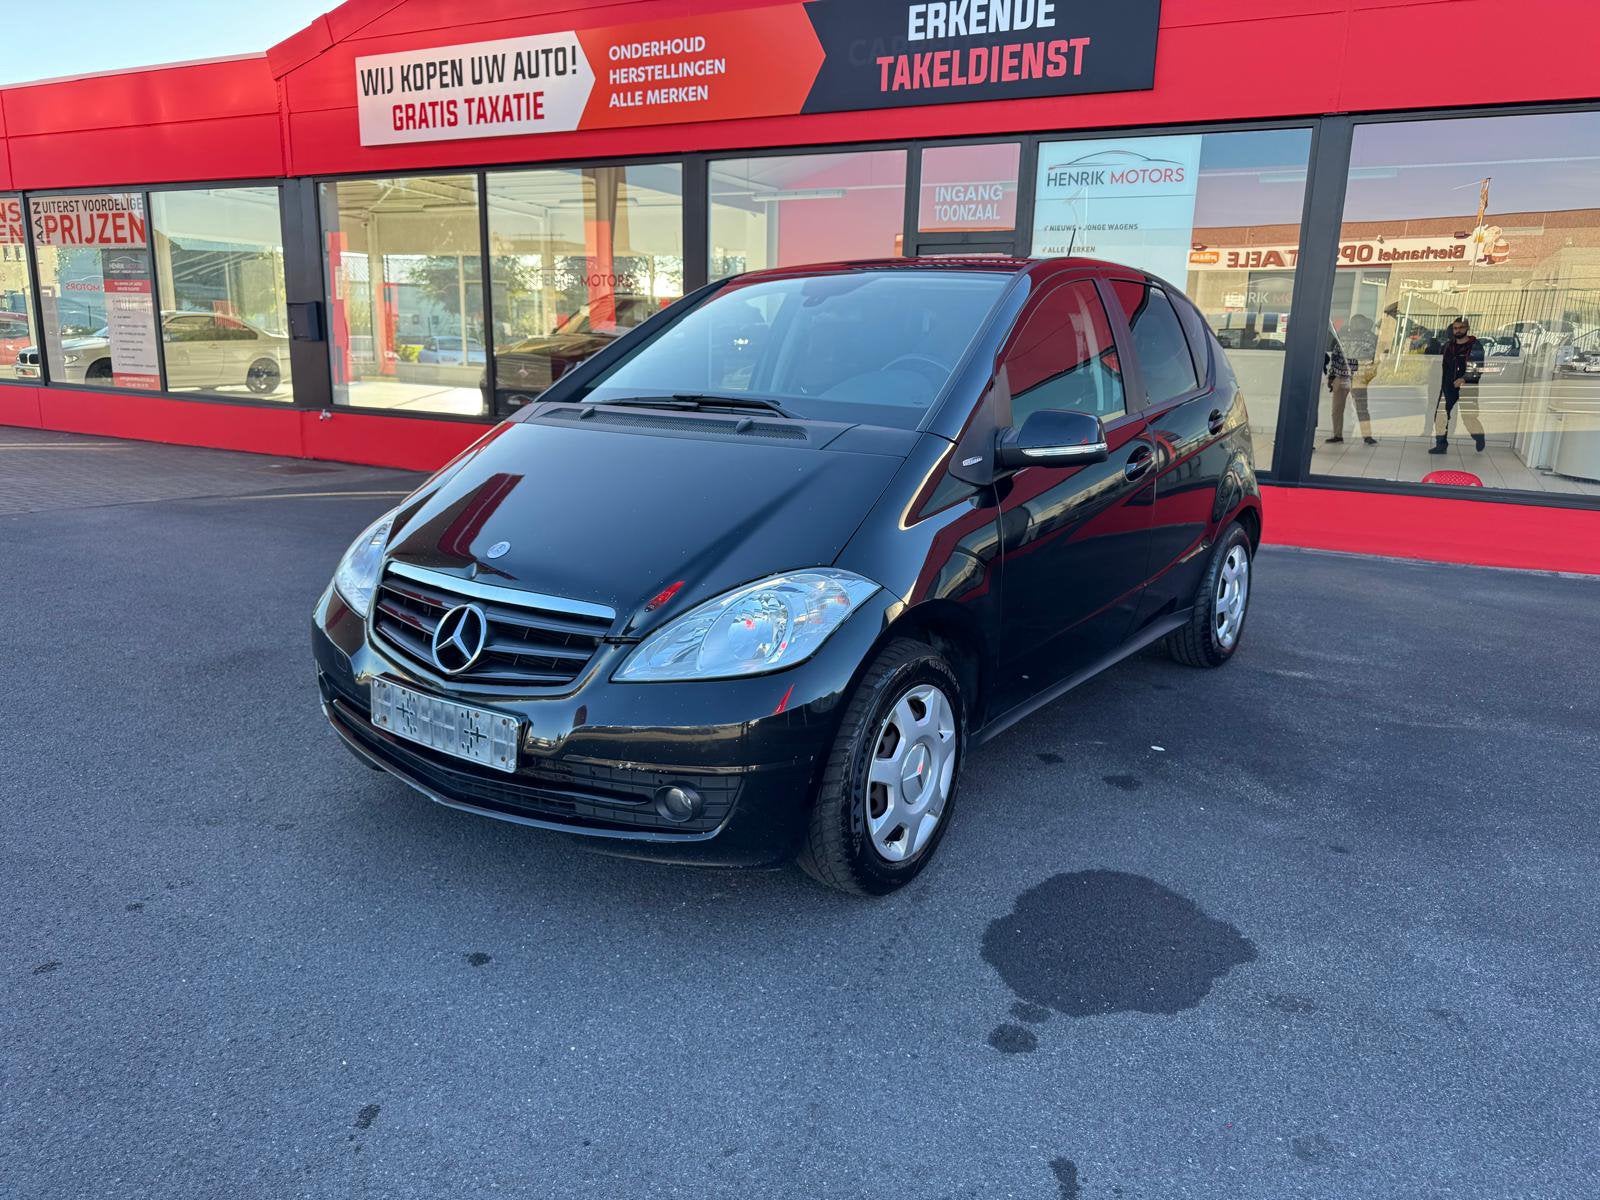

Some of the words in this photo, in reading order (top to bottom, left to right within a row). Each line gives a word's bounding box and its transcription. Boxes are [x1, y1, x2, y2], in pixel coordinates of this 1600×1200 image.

[908, 0, 1055, 41] ERKENDE
[609, 36, 706, 61] ONDERHOUD
[360, 66, 394, 97] WIJ
[400, 60, 463, 92] KOPEN
[471, 53, 507, 85] UW
[609, 58, 726, 85] HERSTELLINGEN
[876, 37, 1090, 92] TAKELDIENST
[609, 88, 645, 108] ALLE
[647, 85, 709, 106] MERKEN
[392, 97, 458, 131] GRATIS
[464, 91, 545, 127] TAXATIE
[1047, 170, 1105, 187] HENRIK
[1110, 167, 1185, 185] MOTORS
[42, 200, 80, 213] UITERST
[83, 197, 143, 212] VOORDELIGE
[935, 184, 1003, 202] INGANG
[934, 203, 1001, 222] TOONZAAL
[44, 212, 147, 245] PRIJZEN
[1108, 223, 1138, 231] WAGENS
[580, 273, 634, 288] MOTORS
